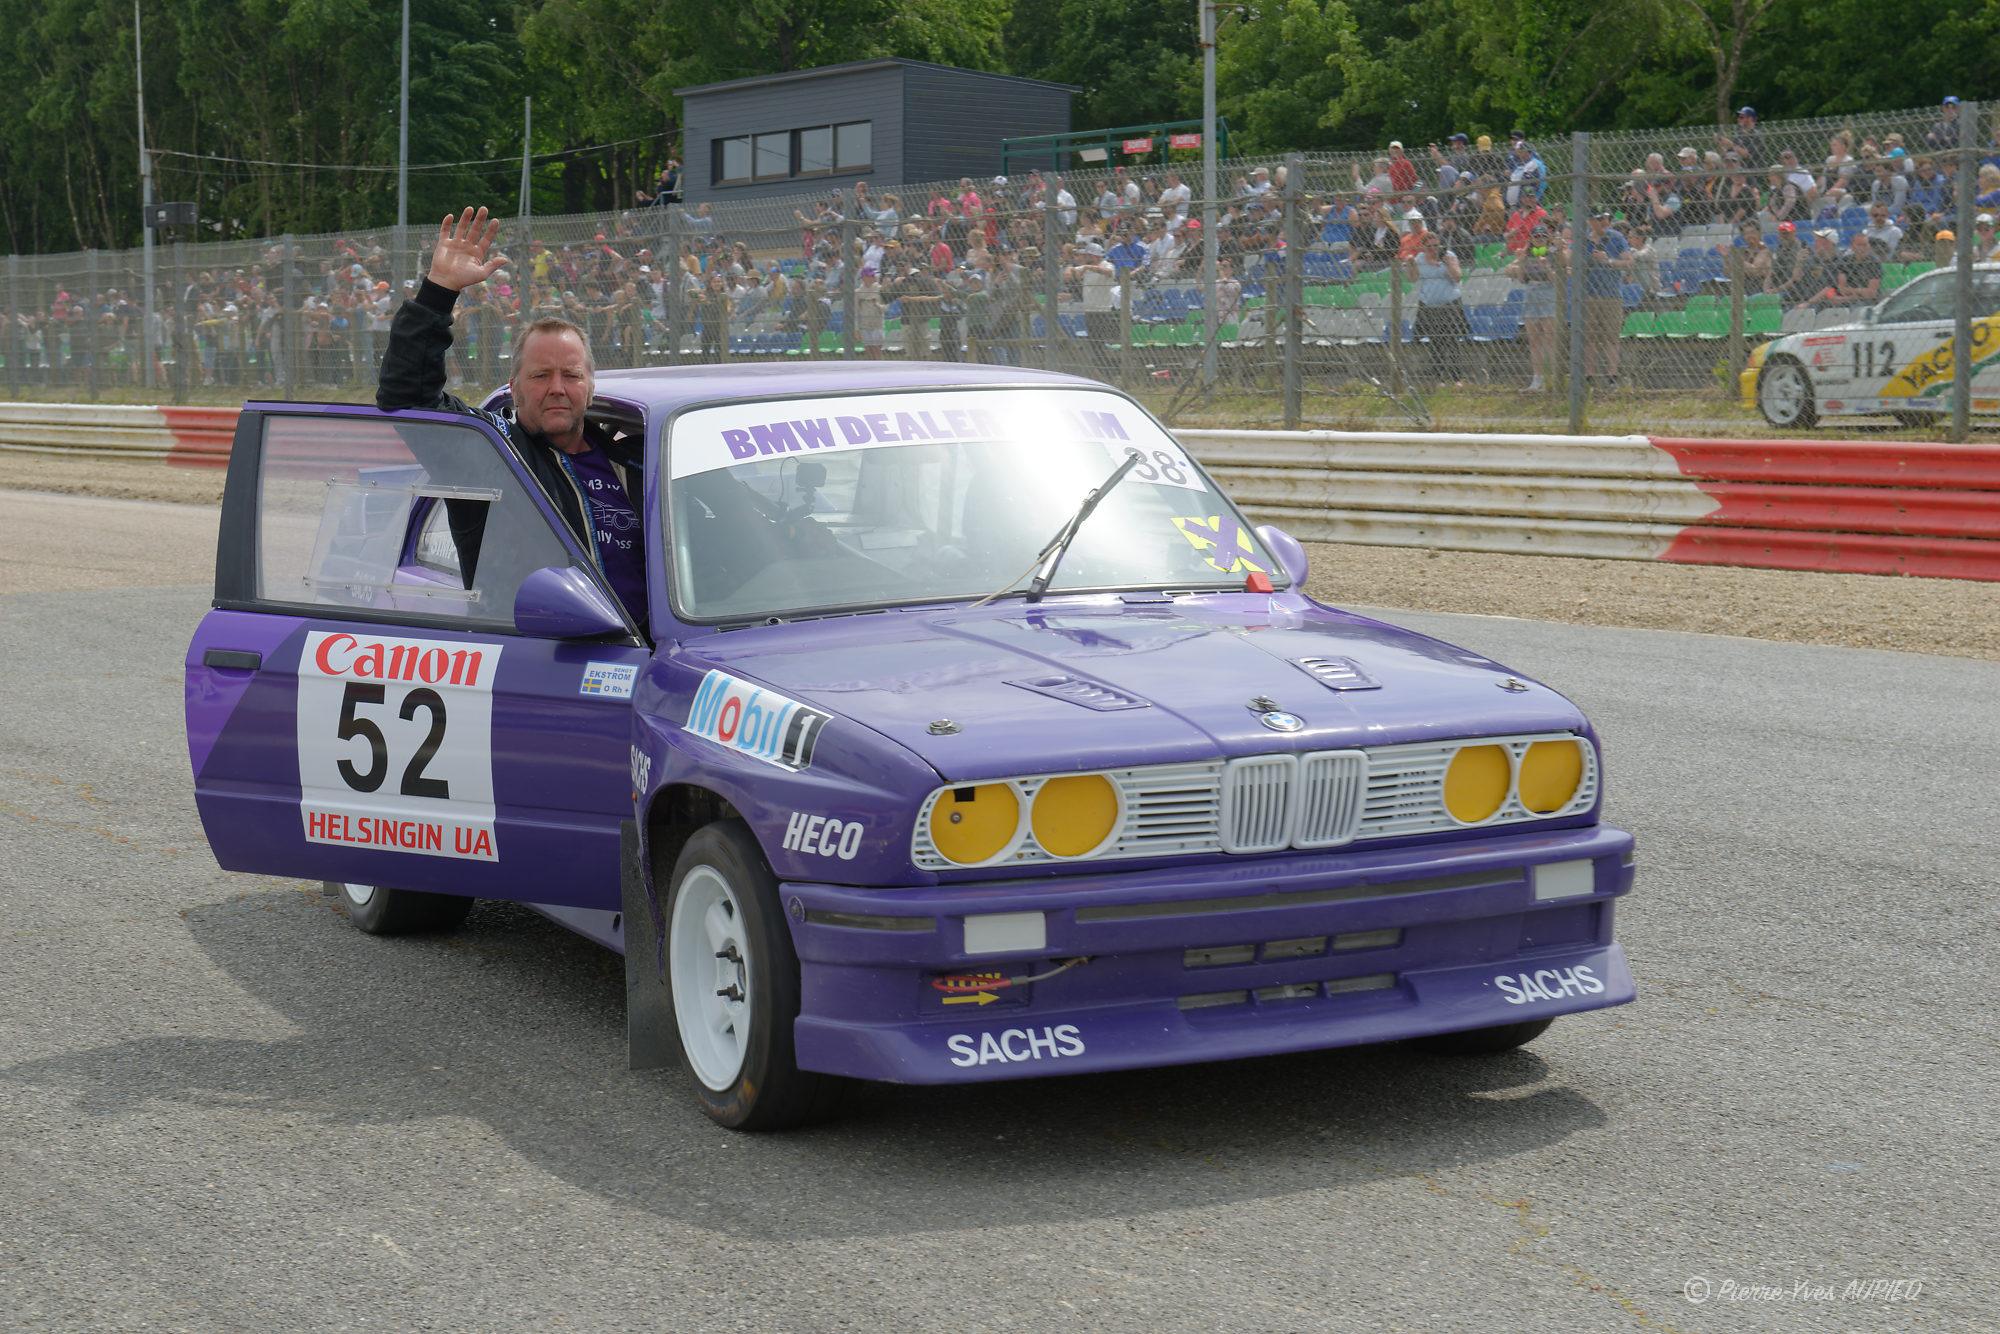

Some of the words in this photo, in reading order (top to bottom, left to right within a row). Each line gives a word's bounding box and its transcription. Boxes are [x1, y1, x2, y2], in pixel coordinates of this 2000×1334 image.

[1852, 341, 1896, 378] 112
[1901, 322, 1991, 390] YACO
[720, 416, 837, 460] BMW
[1123, 446, 1188, 485] 38
[315, 633, 483, 687] Canon
[336, 681, 450, 800] 52
[688, 671, 796, 758] Mobil
[790, 714, 817, 766] 1
[630, 744, 651, 795] SACHS
[308, 811, 443, 852] HELSINGIN
[454, 827, 493, 857] UA
[782, 812, 865, 861] HECO
[1494, 965, 1606, 1005] SACHS
[947, 1024, 1086, 1067] SACHS
